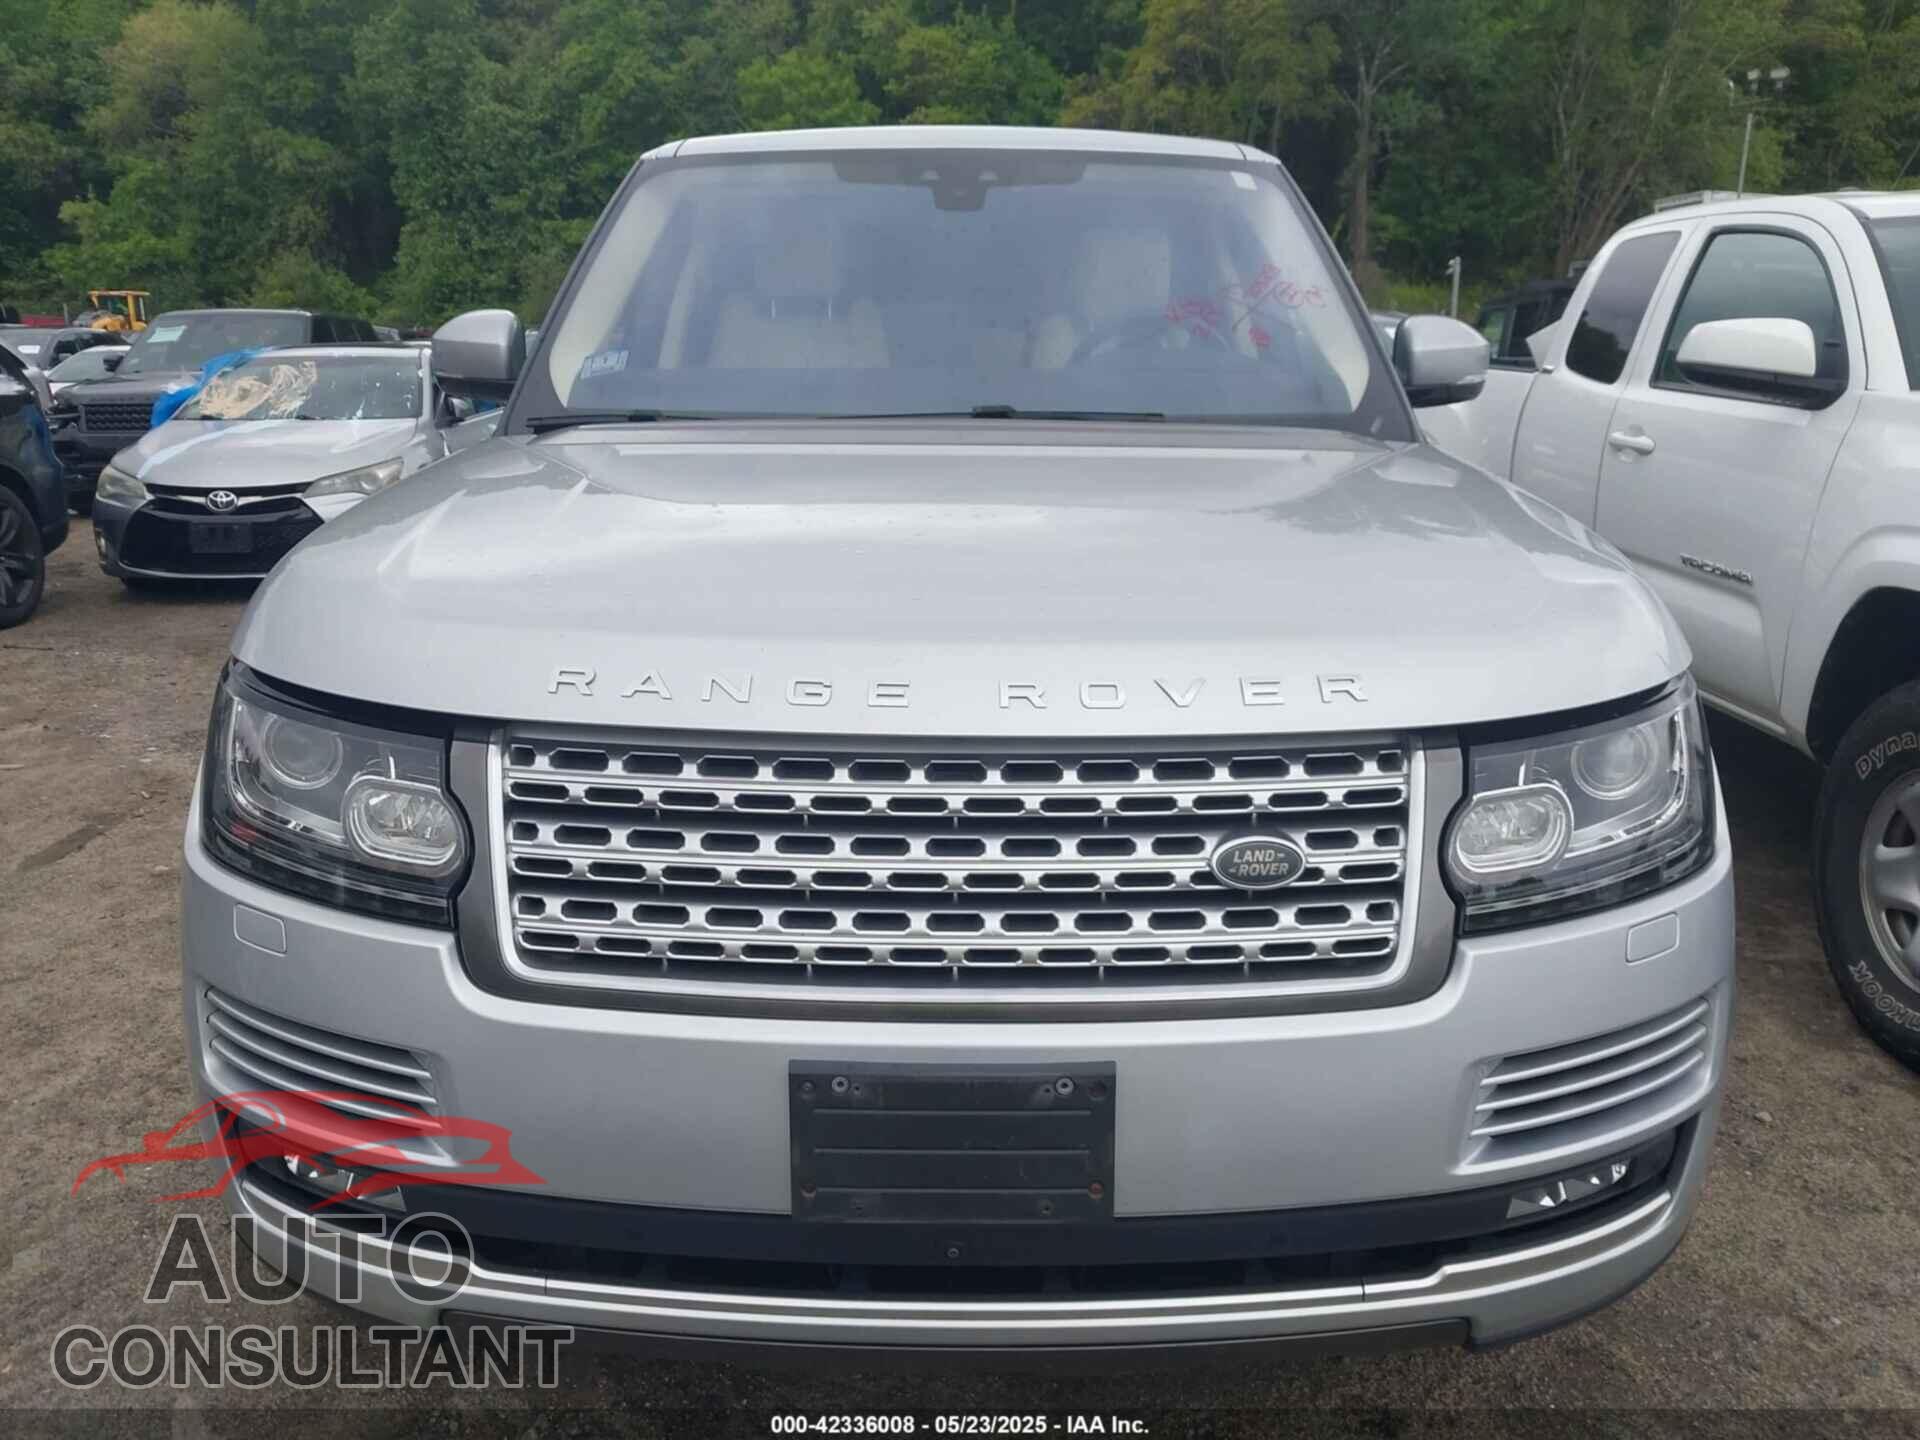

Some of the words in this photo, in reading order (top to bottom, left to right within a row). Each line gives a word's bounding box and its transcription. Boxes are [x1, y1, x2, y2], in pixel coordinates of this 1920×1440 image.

[547, 665, 911, 709] RANGE
[998, 672, 1369, 709] ROVER
[1855, 731, 1920, 780] Dyna
